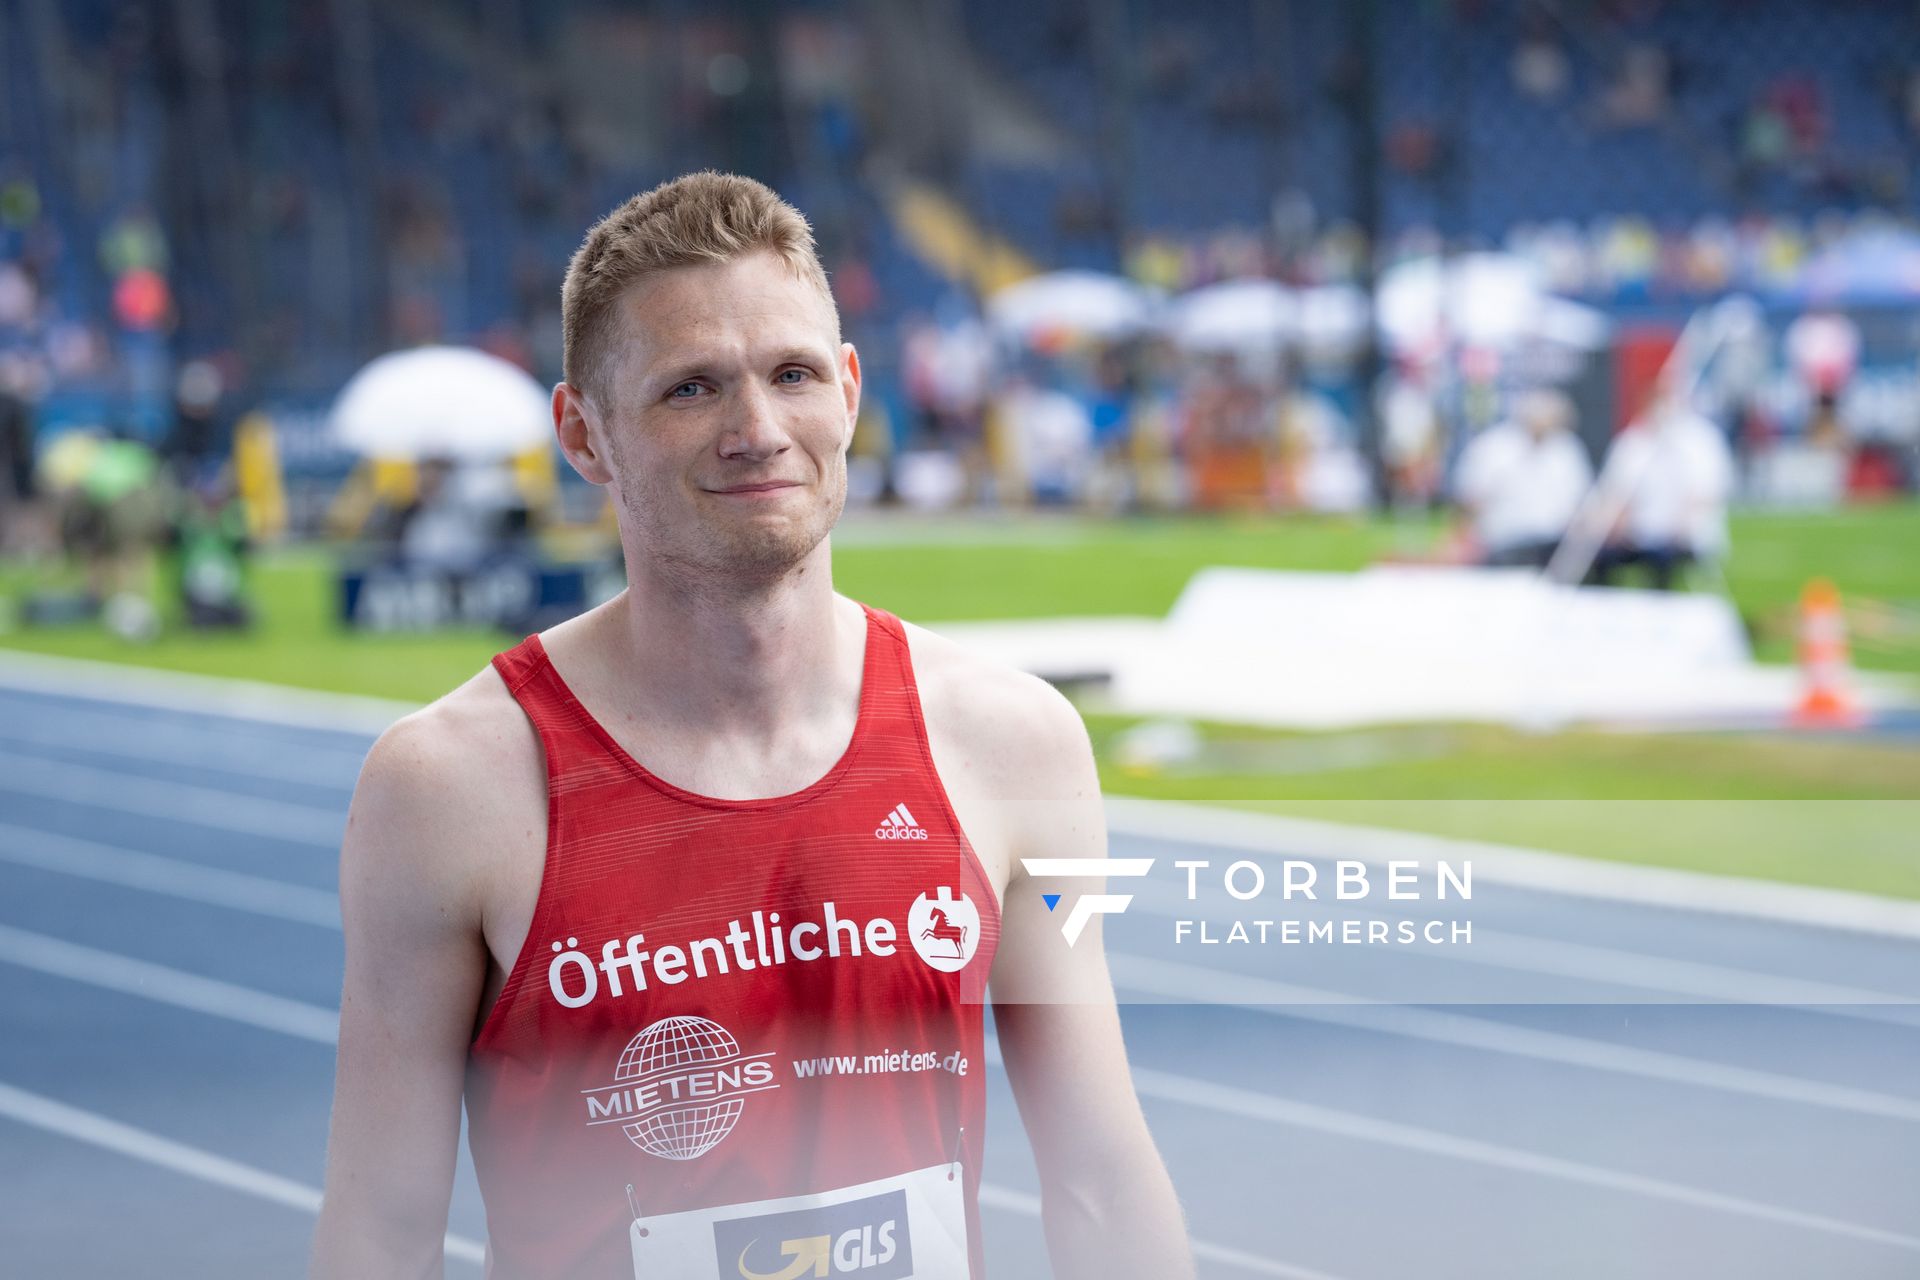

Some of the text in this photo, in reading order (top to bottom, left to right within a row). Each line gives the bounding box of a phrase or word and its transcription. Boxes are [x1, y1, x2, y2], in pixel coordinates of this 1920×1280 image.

[875, 825, 928, 841] adidas
[548, 902, 898, 1009] Öffentliche
[586, 1061, 774, 1119] MIETENS
[792, 1047, 969, 1079] www.mietens.de
[833, 1219, 897, 1273] GLS
